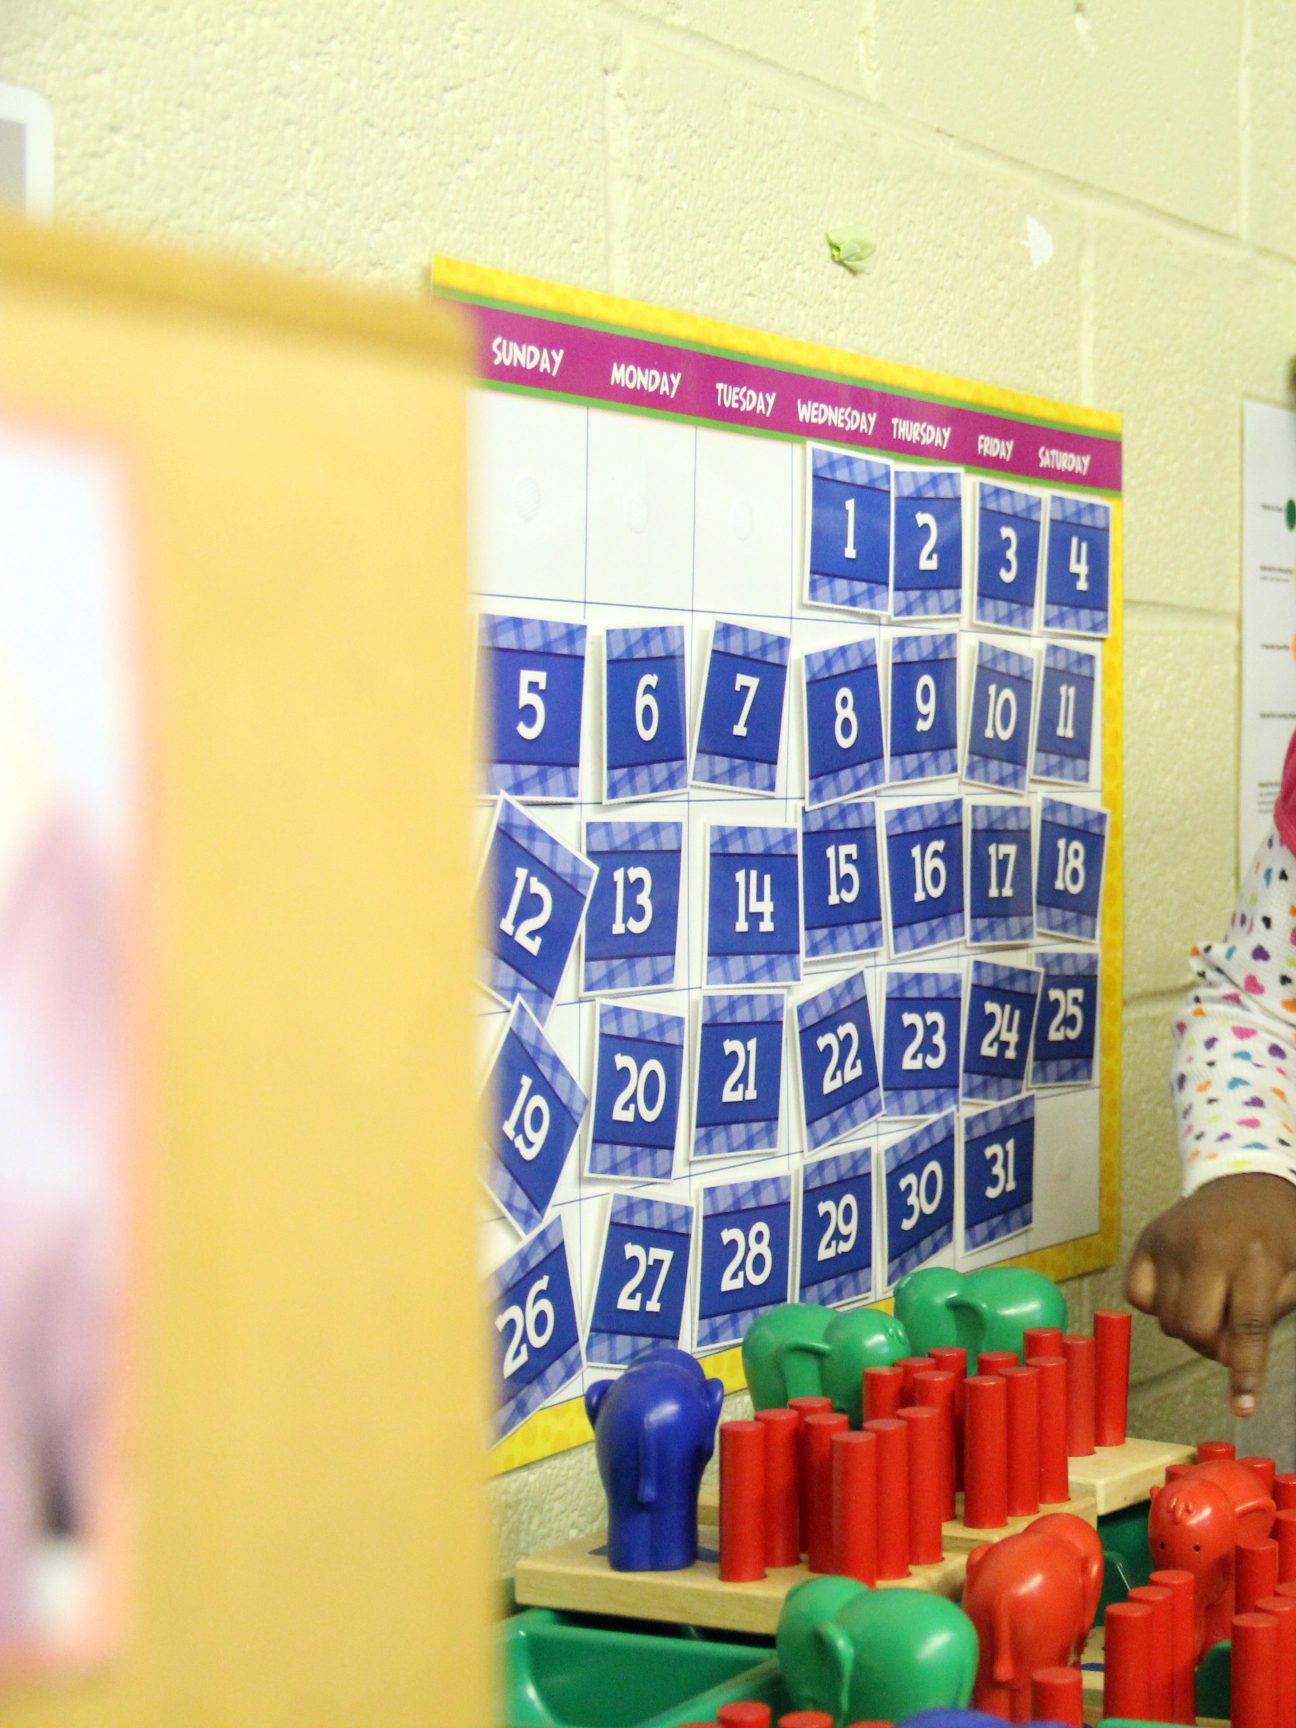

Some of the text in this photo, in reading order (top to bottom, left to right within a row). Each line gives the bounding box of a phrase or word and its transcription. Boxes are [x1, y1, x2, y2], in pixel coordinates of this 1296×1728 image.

[491, 335, 1092, 476] SUNDAY MONDAY TUESDAY WEDNESDAY THURSDAY FRIDAY SATURDAY
[844, 498, 1089, 591] 1 2 3 4
[516, 669, 1076, 749] 5 6 7 8 9 10 11
[499, 837, 1086, 956] 12 13 14 15 16 17 18
[501, 987, 1084, 1161] 19 20 21 22 23 24 25
[494, 1138, 1016, 1379] 26 27 28 29 30 31
